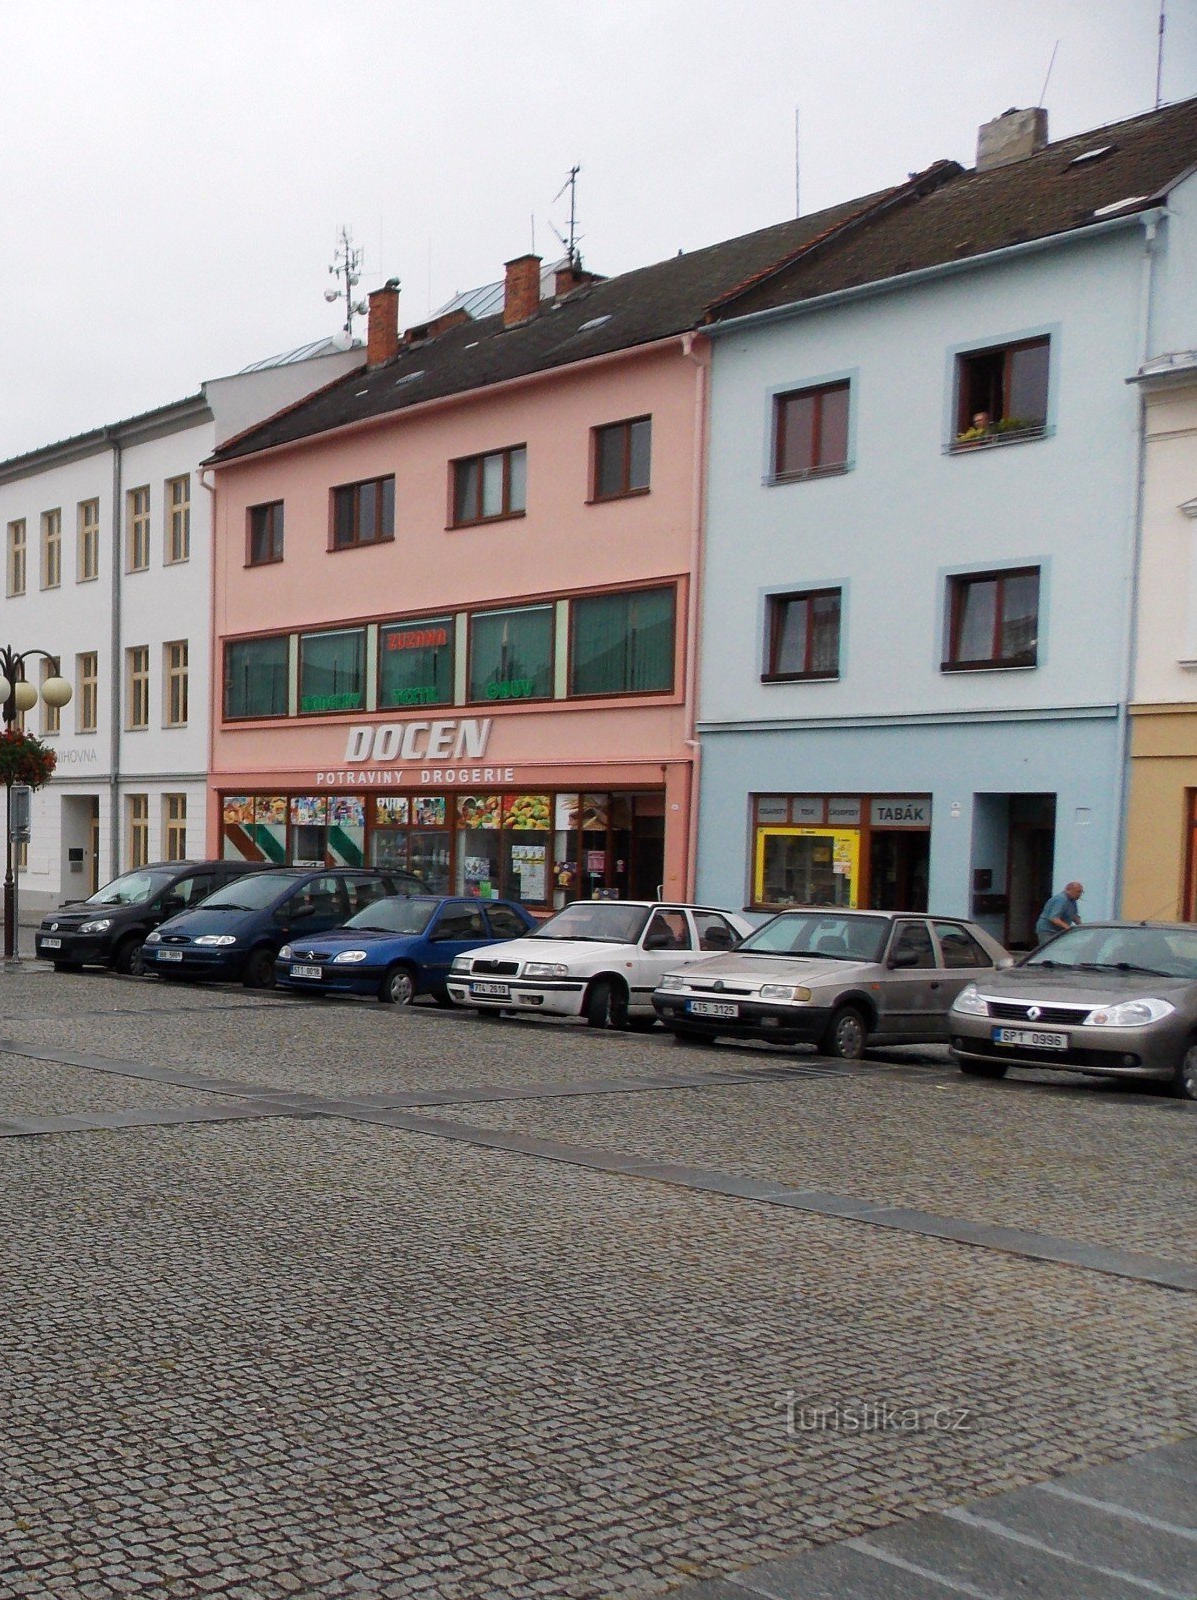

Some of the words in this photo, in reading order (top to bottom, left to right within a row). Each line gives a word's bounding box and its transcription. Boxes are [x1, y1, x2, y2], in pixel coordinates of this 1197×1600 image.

[387, 628, 447, 651] ZUZANA
[486, 679, 534, 699] OBUV
[344, 718, 493, 763] DOCEN
[56, 749, 98, 764] NIHOVNA
[316, 770, 404, 785] POTRAVINY
[421, 767, 515, 783] DROGERIE
[877, 804, 924, 821] TABÁK
[692, 1001, 708, 1012] 4T5
[713, 1004, 736, 1015] 3125
[1003, 1030, 1024, 1042] 6P1
[1031, 1033, 1063, 1046] 0996
